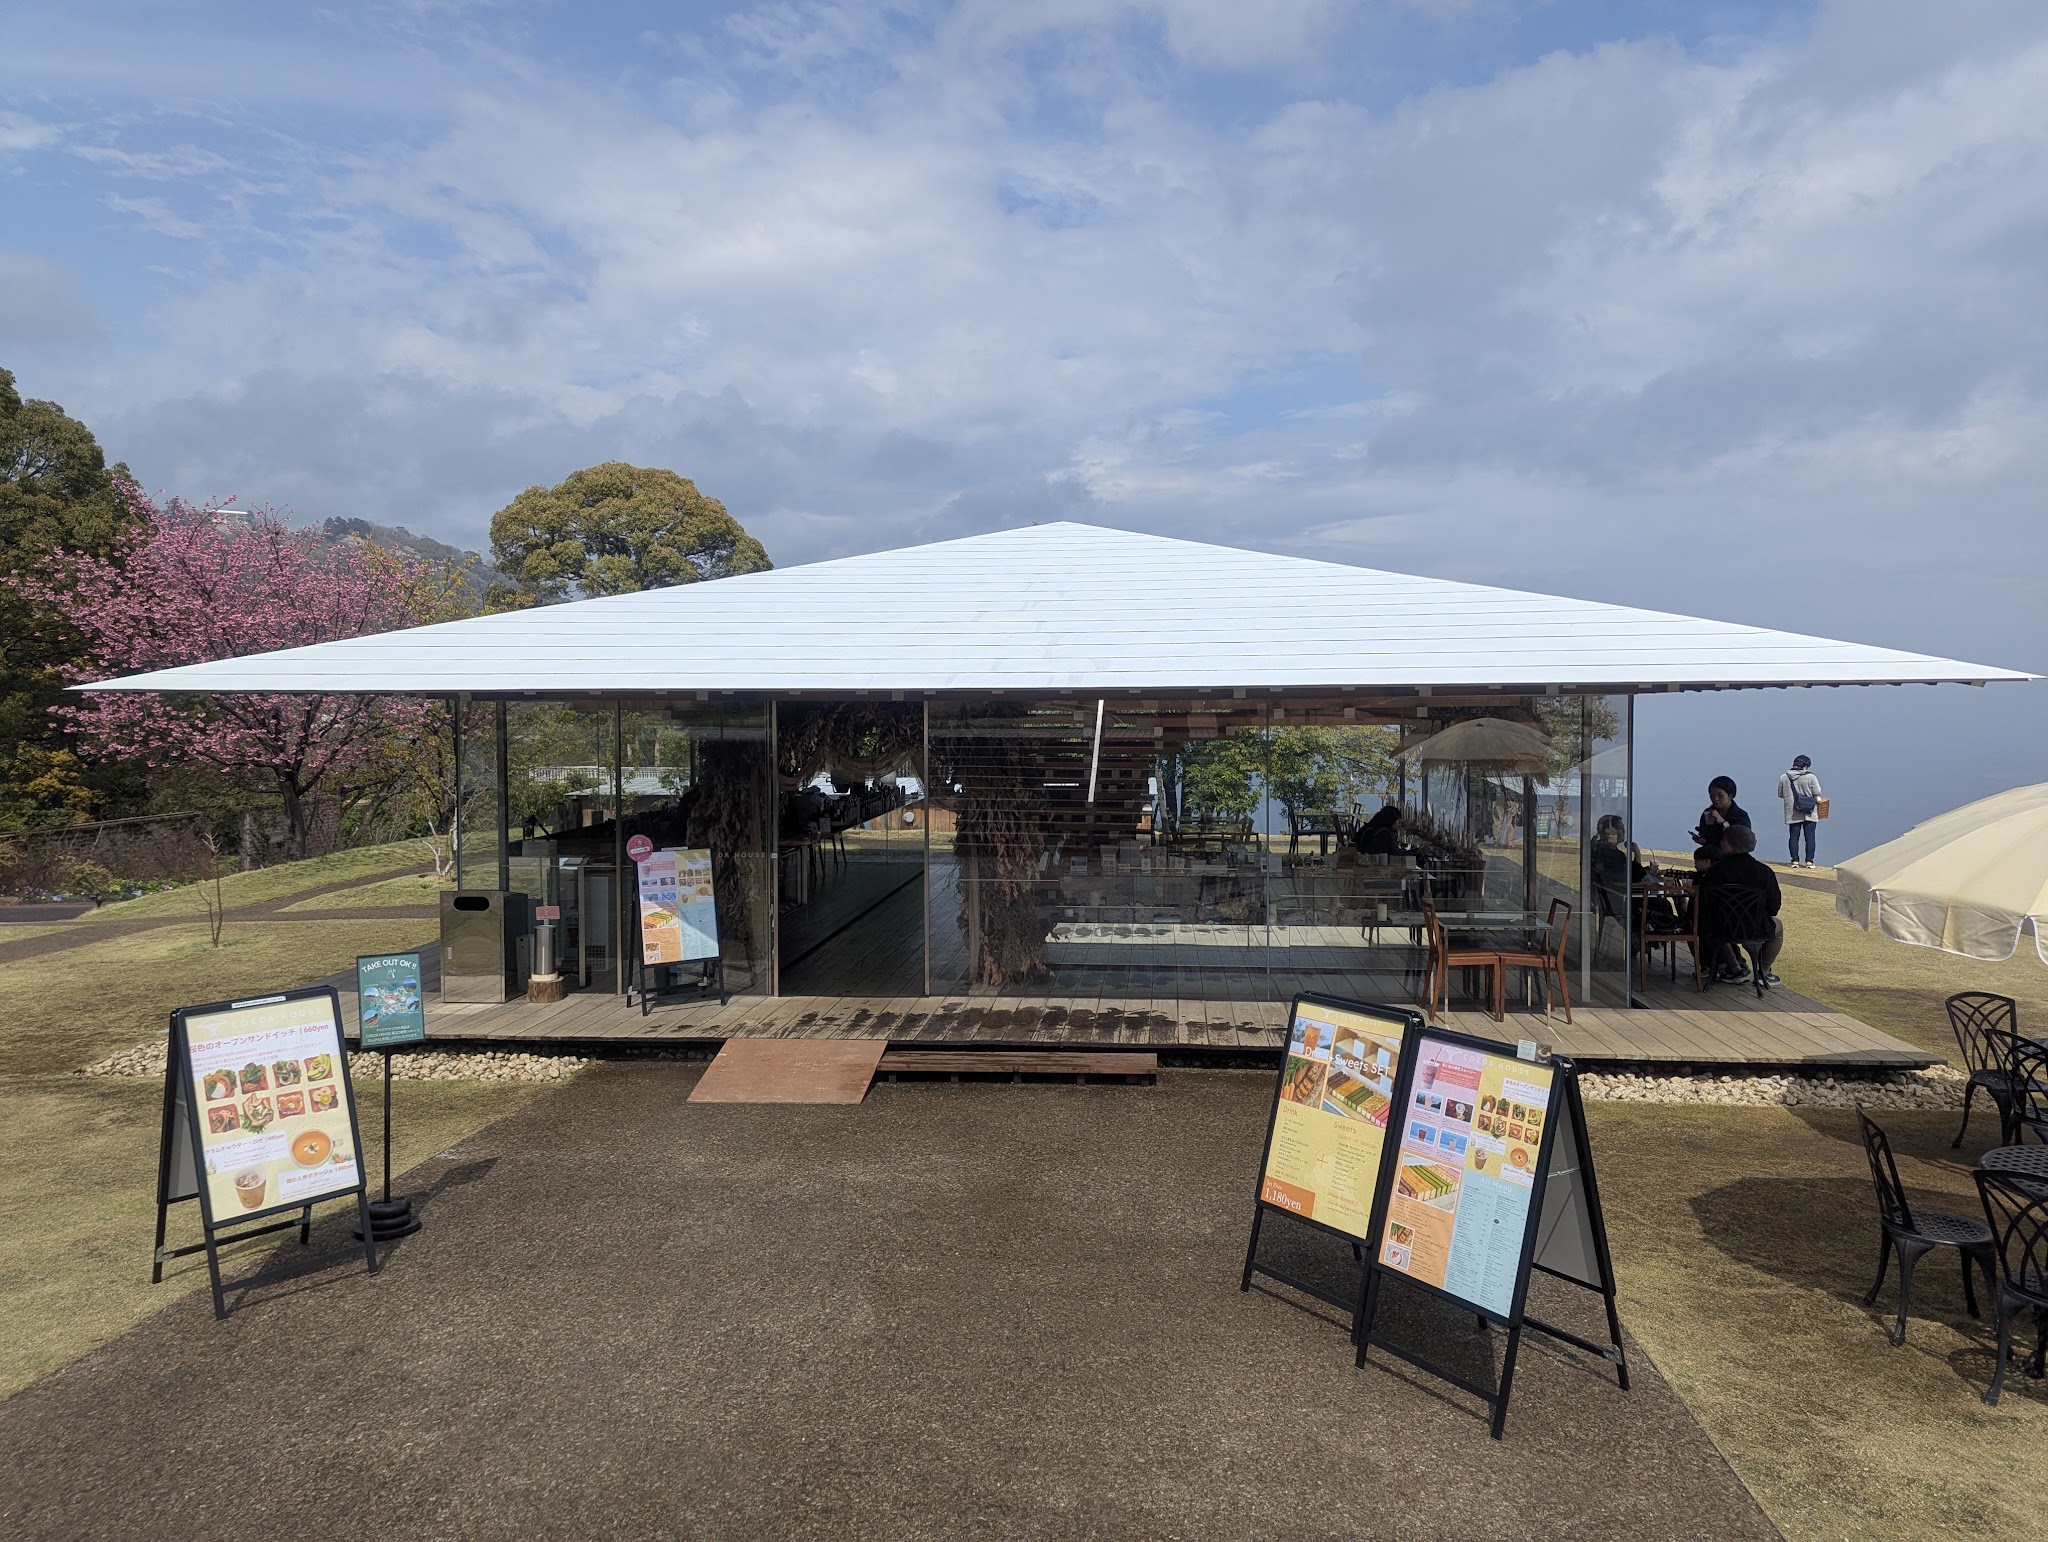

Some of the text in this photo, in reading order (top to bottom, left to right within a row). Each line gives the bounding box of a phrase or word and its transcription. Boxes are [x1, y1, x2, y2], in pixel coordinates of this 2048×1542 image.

[361, 960, 382, 974] TAKE
[382, 958, 399, 967] OUT
[399, 959, 411, 968] OK
[231, 1008, 322, 1028] COEDA HOUSE
[1336, 1013, 1382, 1028] COEDA HOUSE
[303, 1023, 329, 1034] 660yen
[1370, 1063, 1391, 1077] SET
[1463, 1053, 1530, 1076] COEDA HOUSE
[1282, 1105, 1299, 1117] Drink
[1333, 1121, 1358, 1134] Sweets
[1479, 1176, 1513, 1194] All Menu
[1264, 1187, 1302, 1211] 1,180yen
